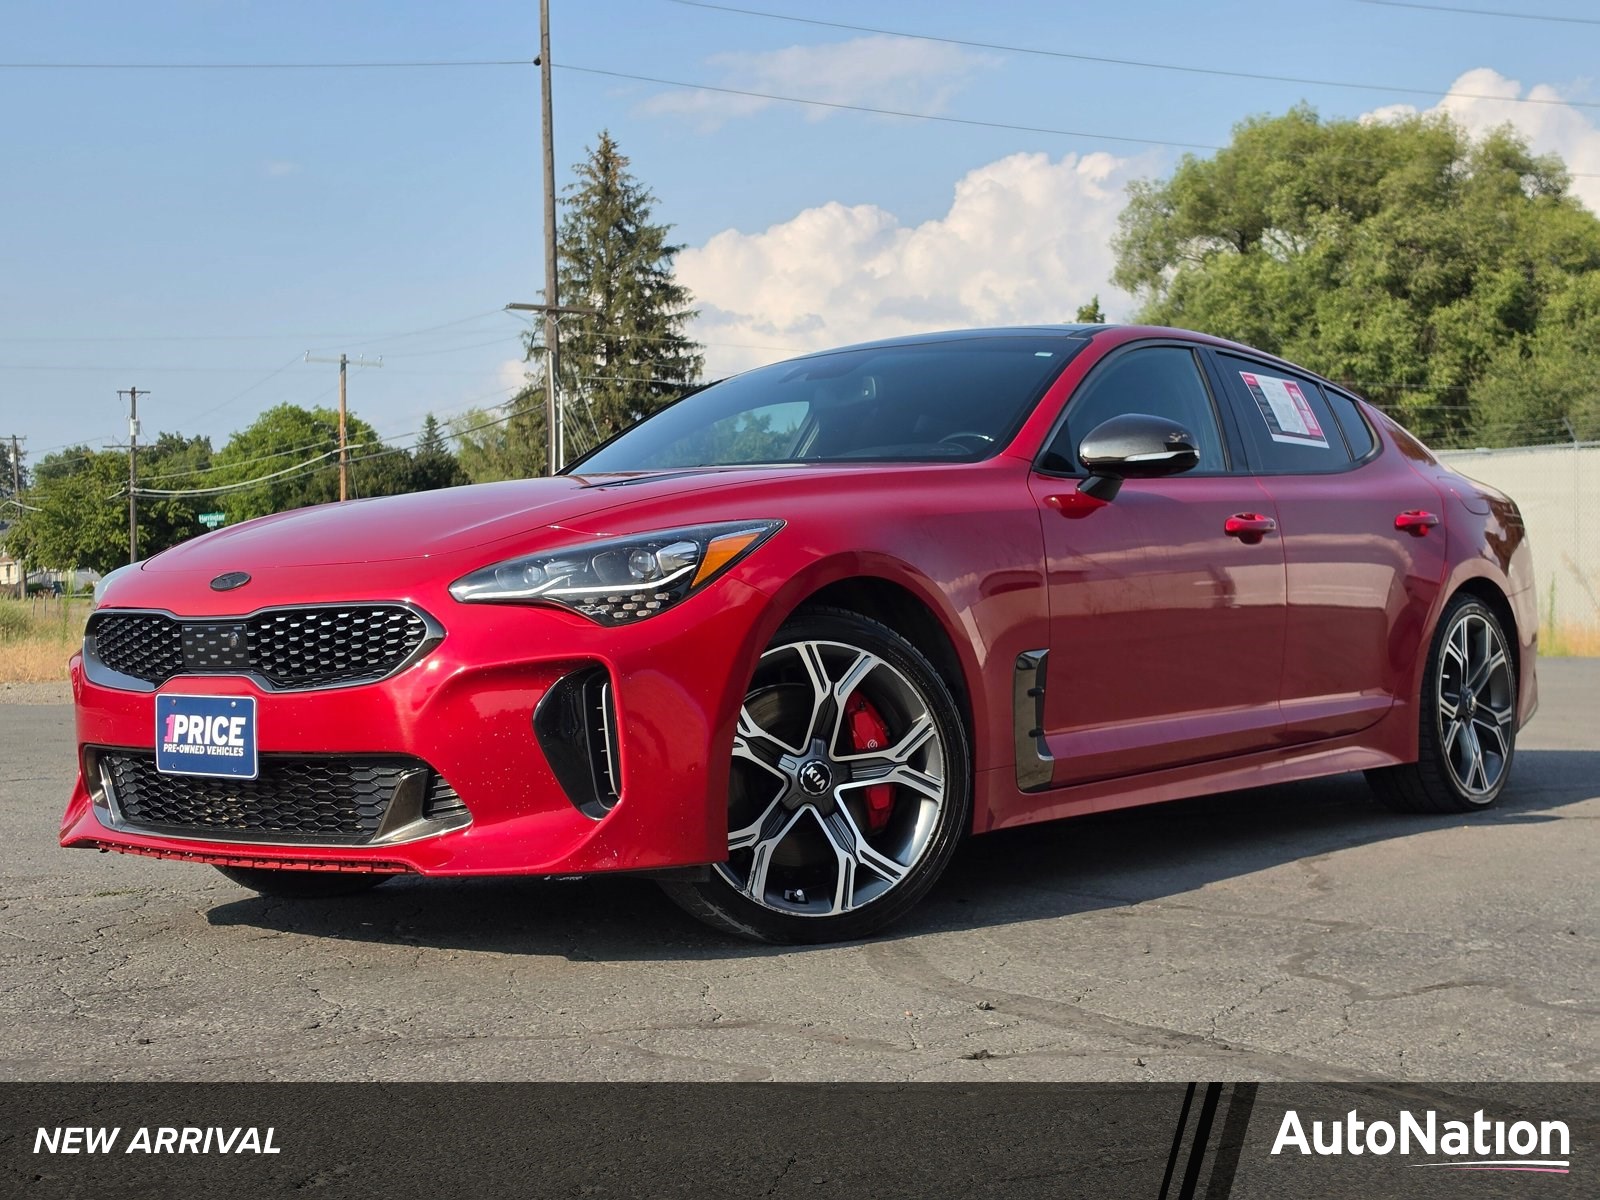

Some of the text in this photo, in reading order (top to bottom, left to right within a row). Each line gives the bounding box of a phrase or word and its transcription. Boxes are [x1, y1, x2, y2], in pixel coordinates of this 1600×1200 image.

[163, 744, 244, 756] PRE-OWNED VEHICLES
[806, 767, 826, 789] KIA
